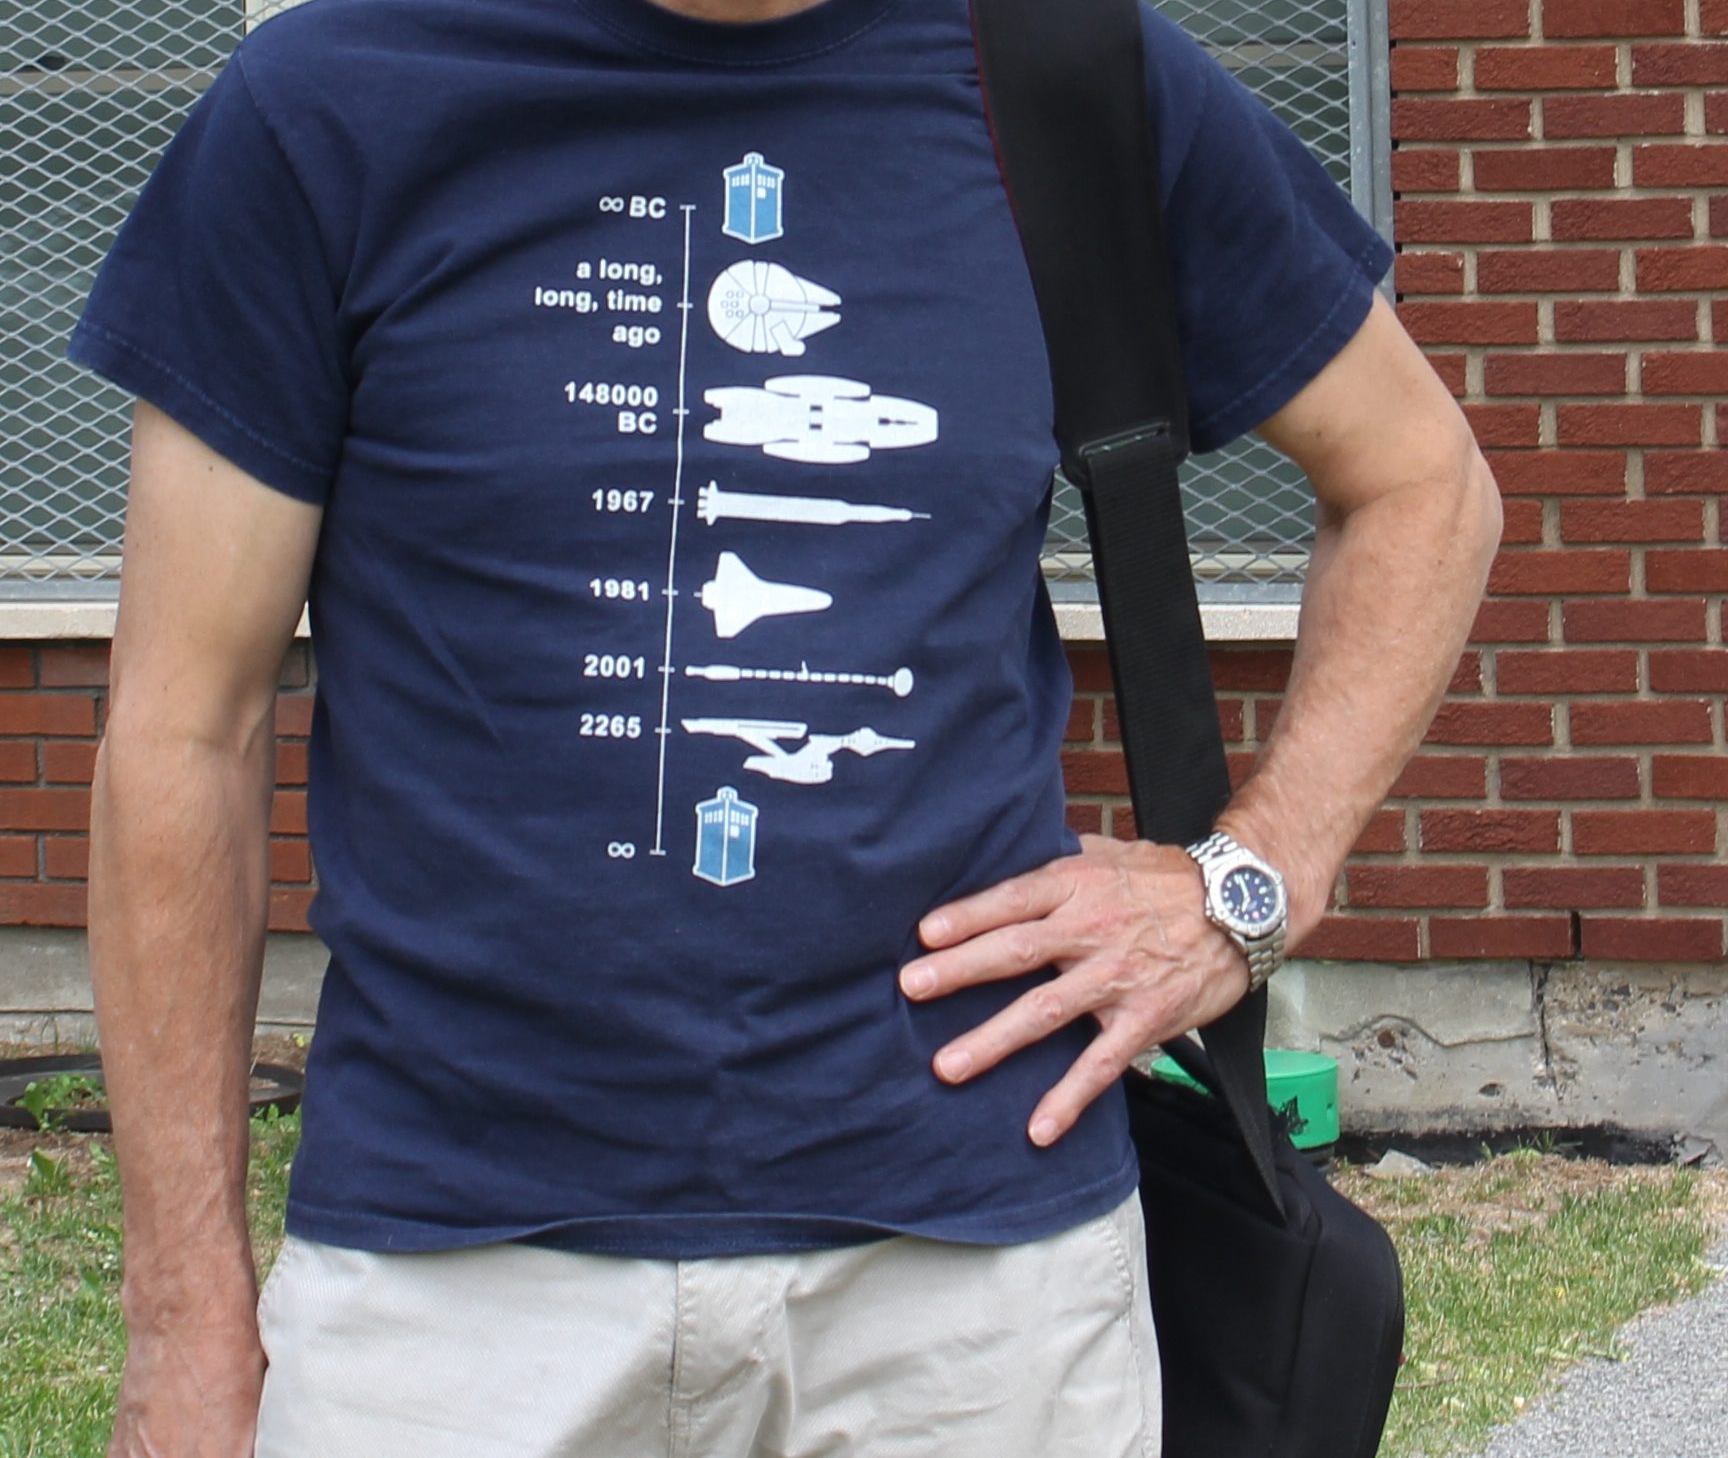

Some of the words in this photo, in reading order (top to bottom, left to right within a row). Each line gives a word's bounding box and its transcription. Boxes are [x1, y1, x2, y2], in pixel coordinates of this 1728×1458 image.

[628, 194, 667, 220] BC
[575, 260, 593, 280] a
[598, 258, 664, 286] long,
[533, 285, 600, 314] long,
[606, 290, 663, 314] time
[611, 324, 662, 348] ago
[563, 381, 660, 409] 148000
[617, 410, 659, 435] BC
[590, 488, 655, 514] 1967
[588, 577, 651, 603] 1981
[582, 653, 646, 680] 2001
[578, 712, 643, 740] 2265
